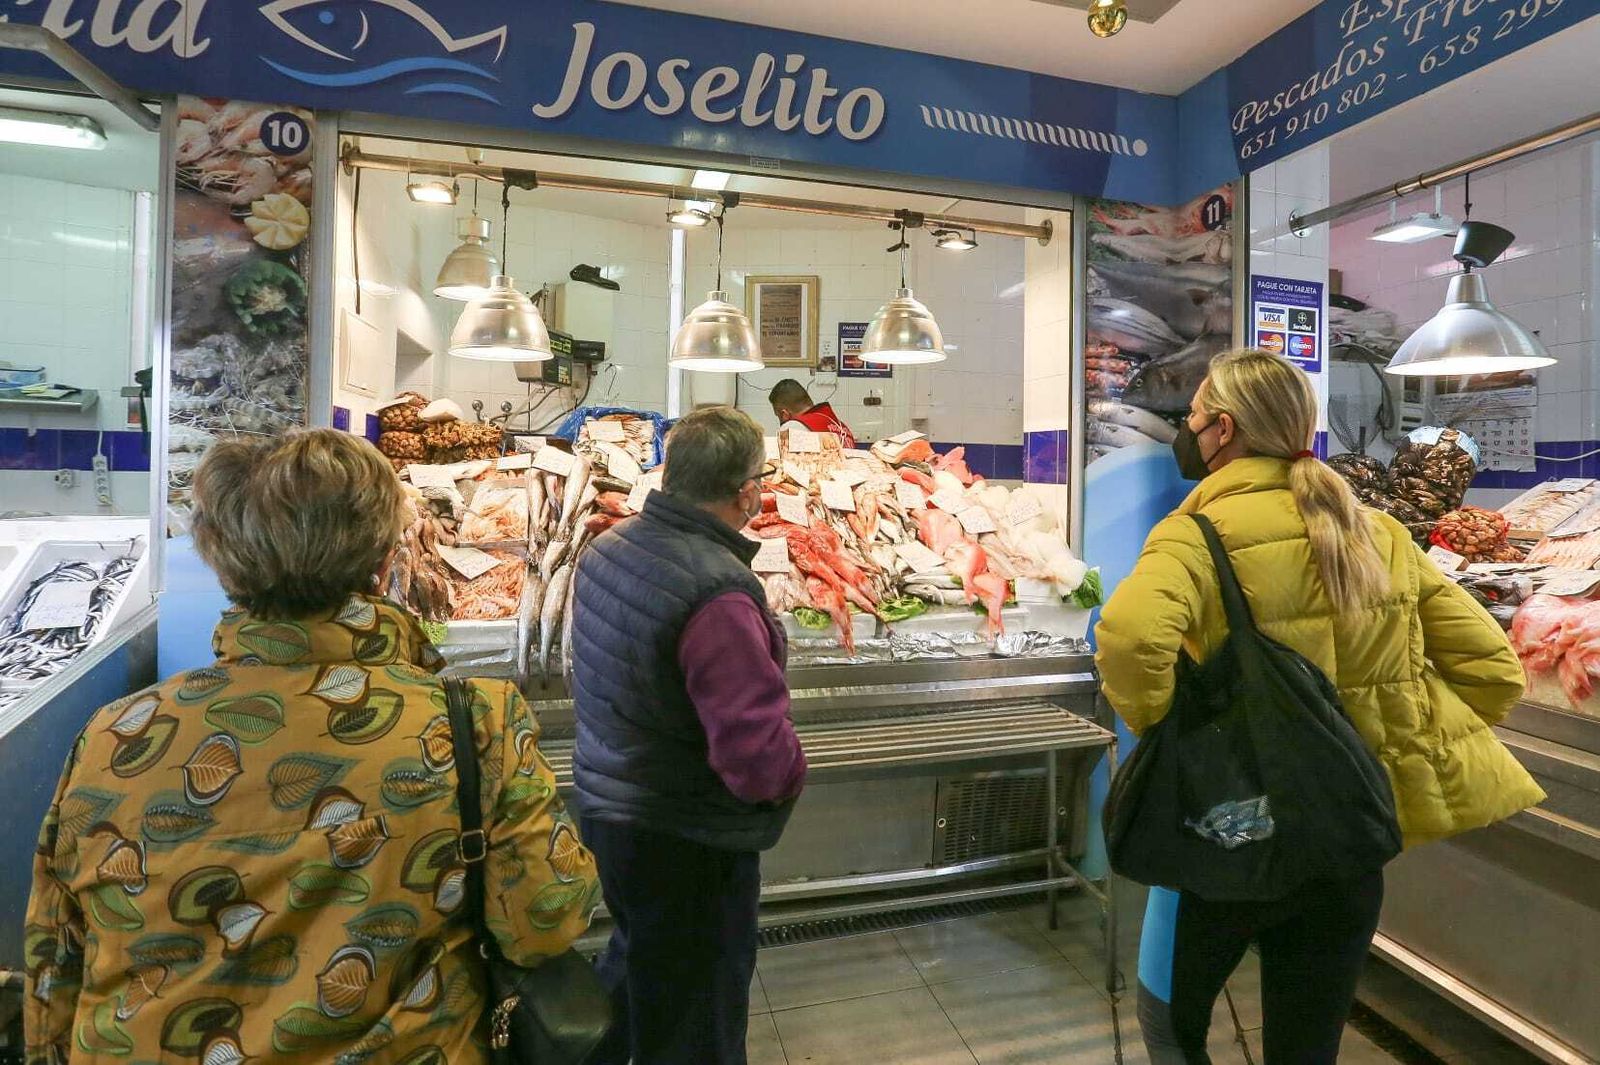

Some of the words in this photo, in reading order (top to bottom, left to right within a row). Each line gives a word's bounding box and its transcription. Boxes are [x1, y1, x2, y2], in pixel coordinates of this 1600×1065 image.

[532, 22, 885, 141] Joselito
[1232, 35, 1388, 135] Pescados
[1240, 129, 1277, 160] 651
[1285, 103, 1329, 140] 910
[1336, 73, 1388, 114] 802
[1419, 25, 1483, 75] 658
[267, 120, 303, 149] 10
[1206, 200, 1220, 224] 11
[1257, 280, 1278, 290] PAGUE
[1278, 283, 1294, 292] CON
[1293, 285, 1317, 295] TARJETA
[1263, 313, 1281, 322] VISA
